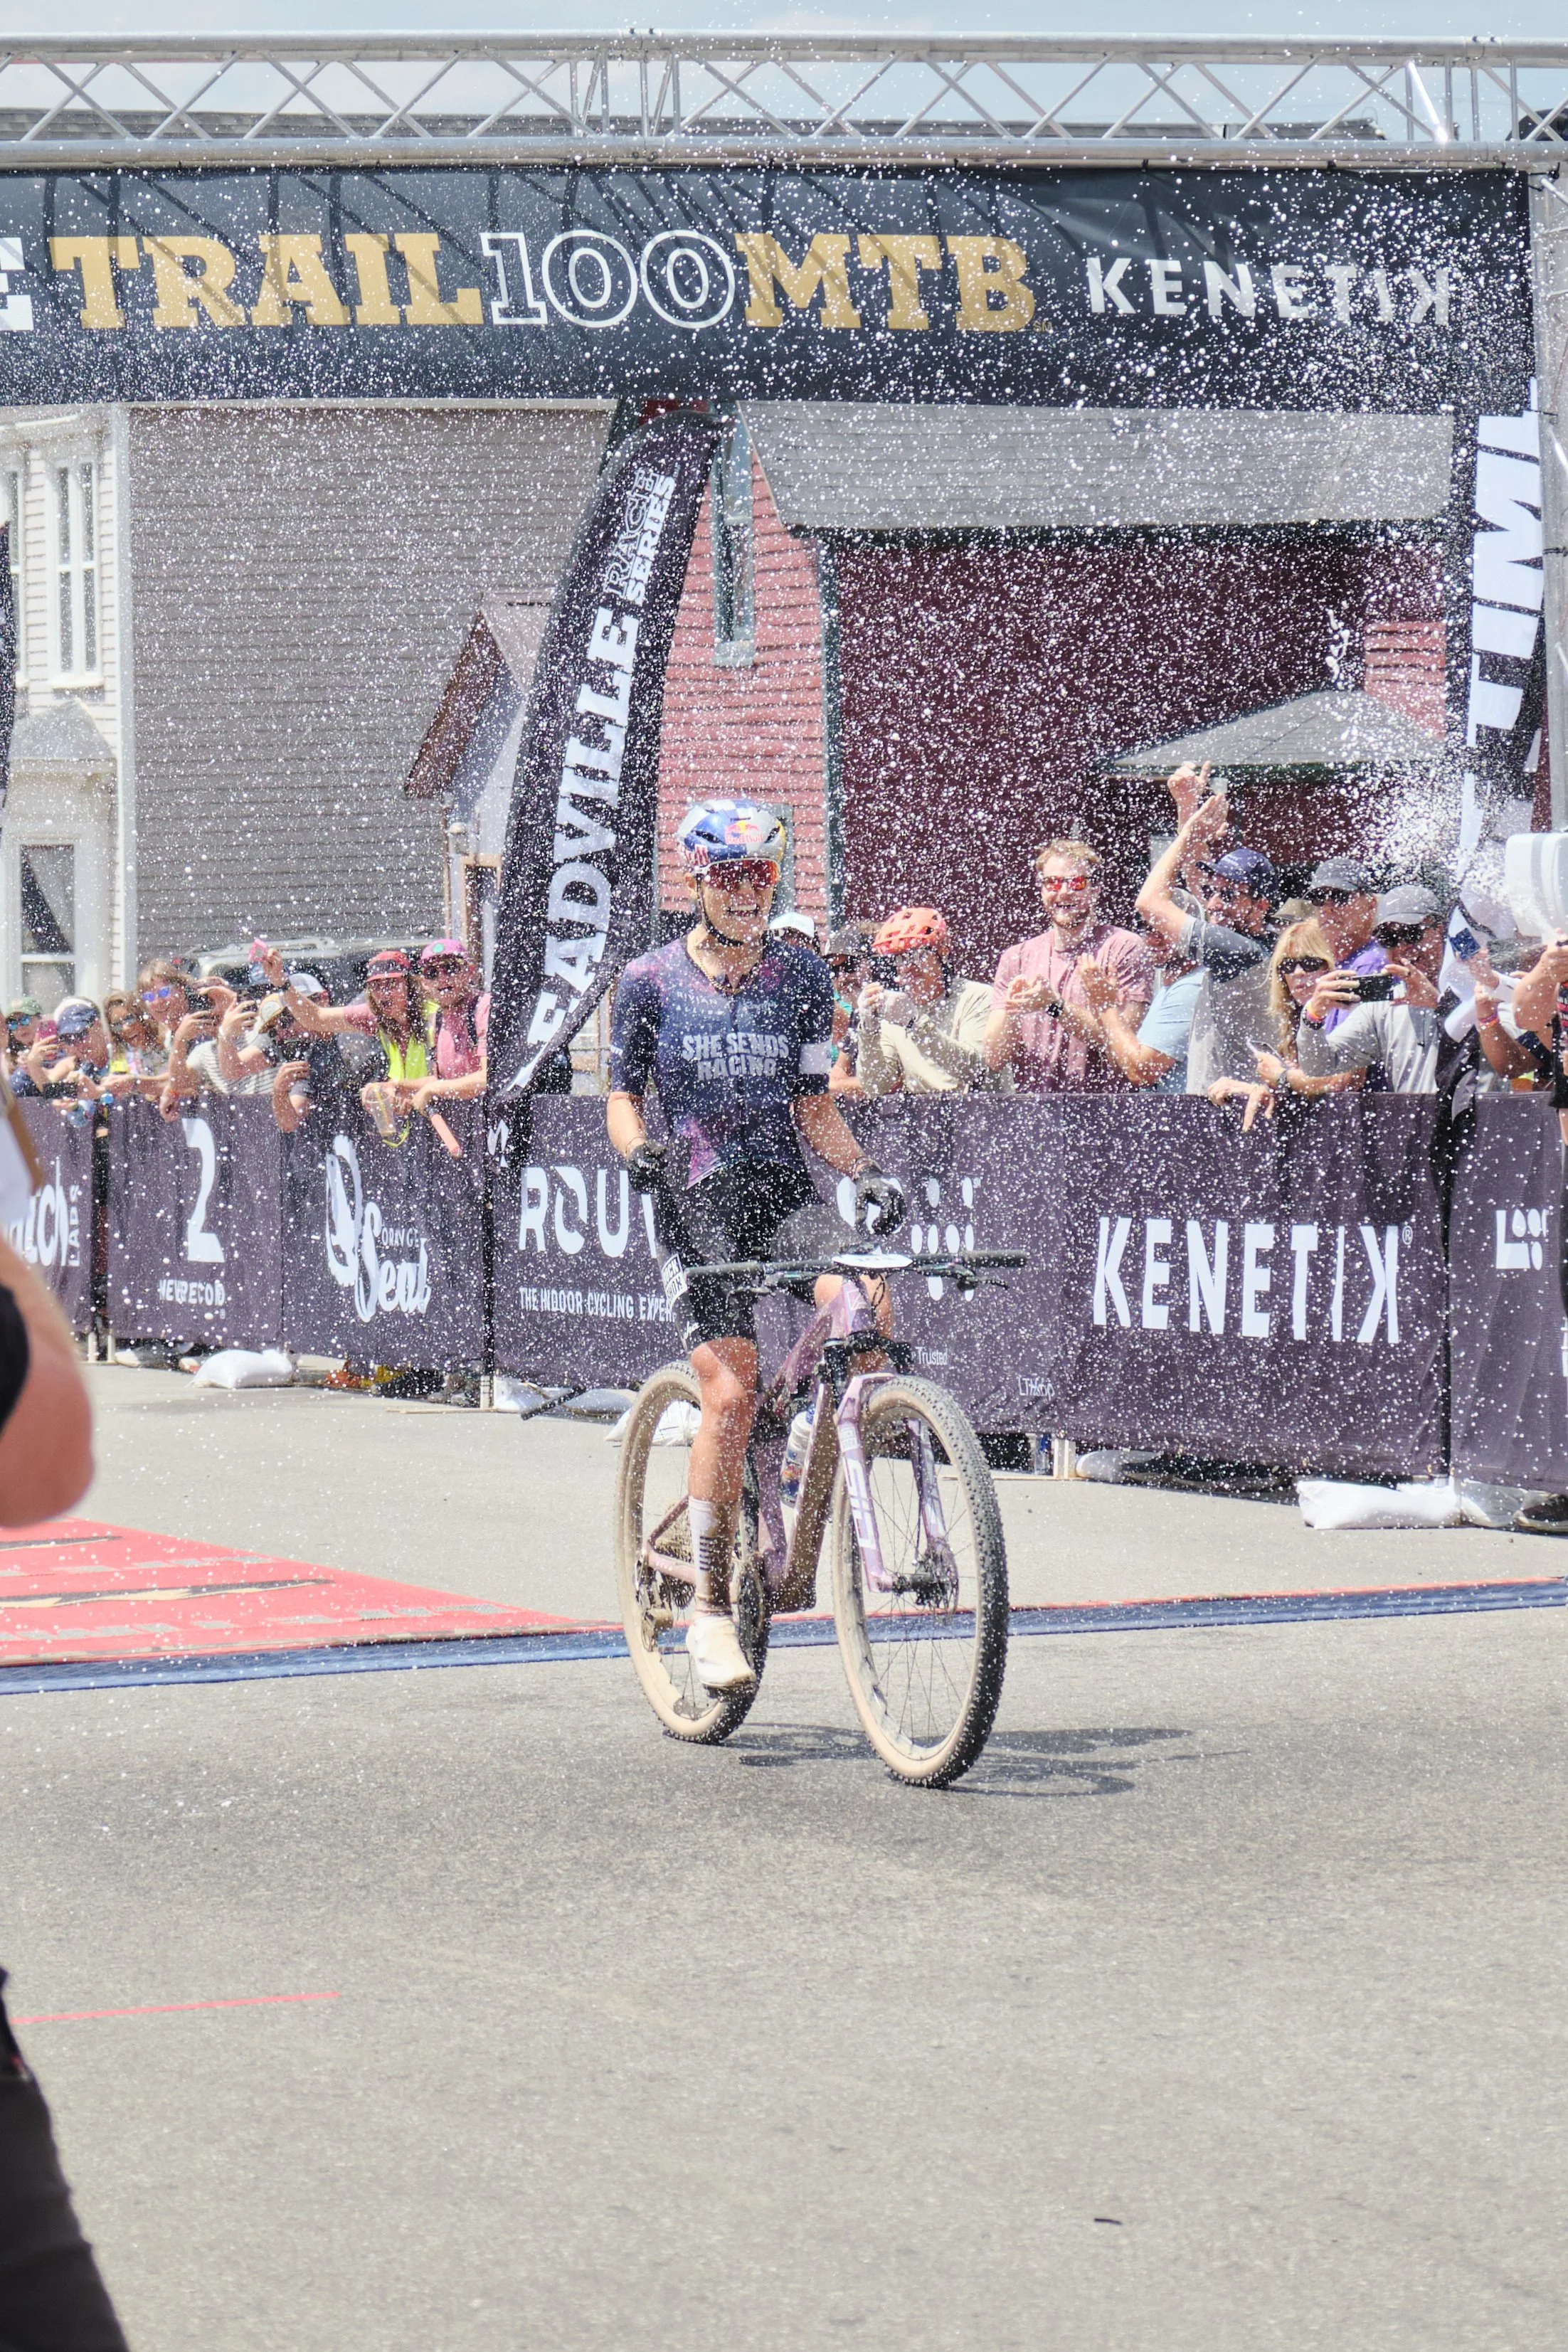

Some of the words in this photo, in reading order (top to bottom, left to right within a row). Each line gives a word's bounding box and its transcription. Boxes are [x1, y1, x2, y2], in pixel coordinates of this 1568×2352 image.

[48, 233, 483, 329] TRAIL
[480, 229, 735, 328] 100
[735, 233, 1036, 332] MTB
[1086, 257, 1449, 326] KENETIK
[603, 468, 659, 599] RACE
[624, 475, 676, 607] SERIES
[682, 1034, 723, 1061] SHE
[726, 1032, 790, 1059] SENDS
[697, 1055, 777, 1081] RACING
[354, 1201, 431, 1323] Seal
[519, 1287, 539, 1313] THE
[541, 1288, 583, 1315] INDOOR
[587, 1291, 634, 1320] CYCLING
[1093, 1215, 1400, 1344] KENETIK
[915, 1346, 948, 1366] Trusted
